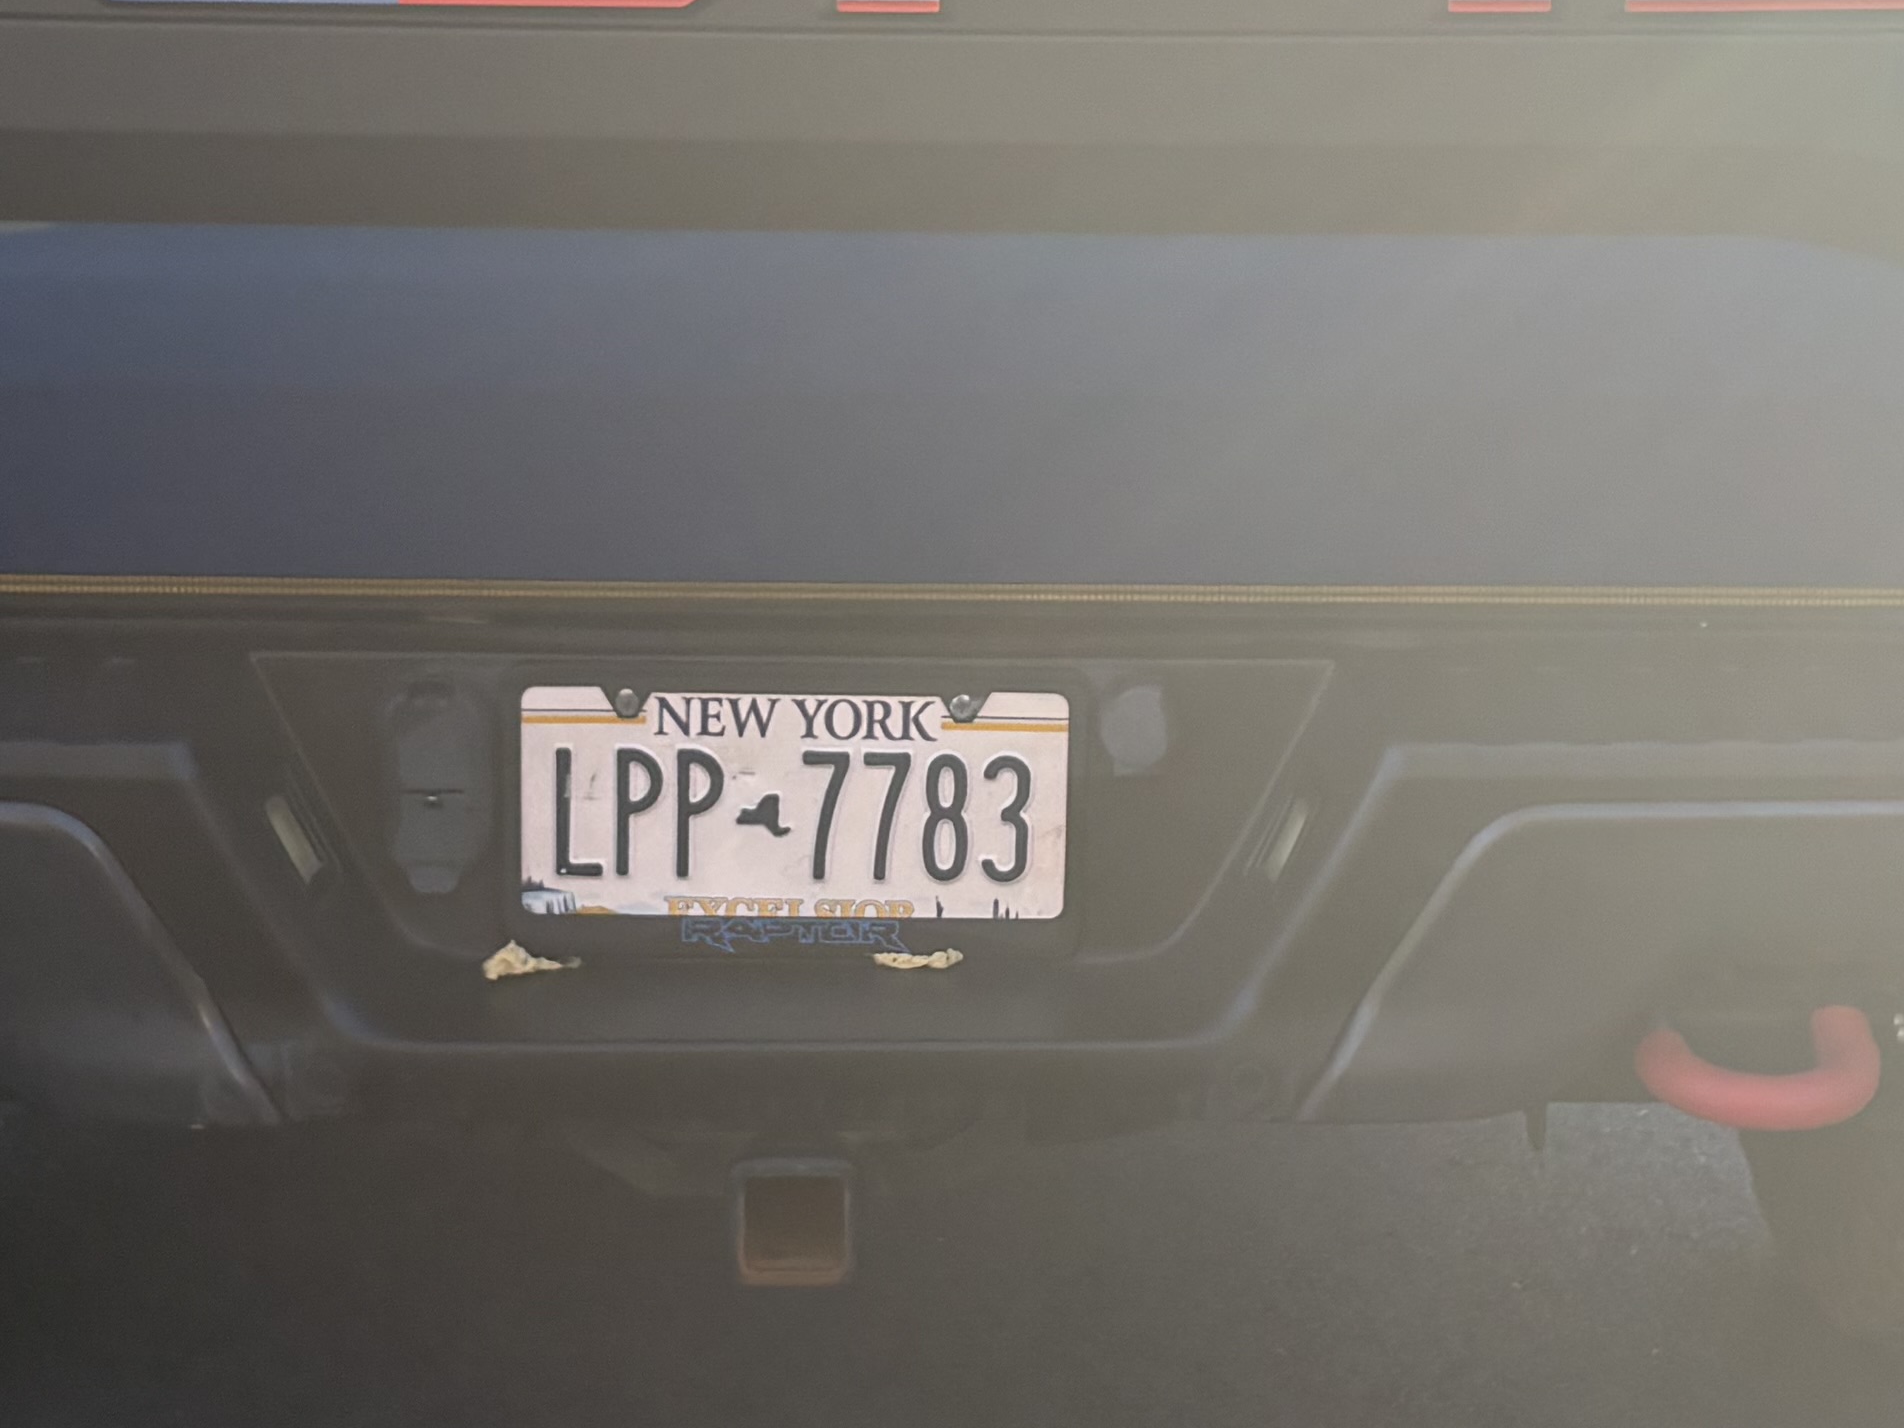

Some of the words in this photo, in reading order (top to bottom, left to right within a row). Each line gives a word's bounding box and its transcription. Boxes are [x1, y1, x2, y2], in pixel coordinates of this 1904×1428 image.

[653, 695, 781, 740] NEW
[791, 698, 939, 743] YORK
[553, 745, 725, 878] LPP
[801, 749, 1032, 883] 7783
[681, 918, 911, 954] RAPTOR
